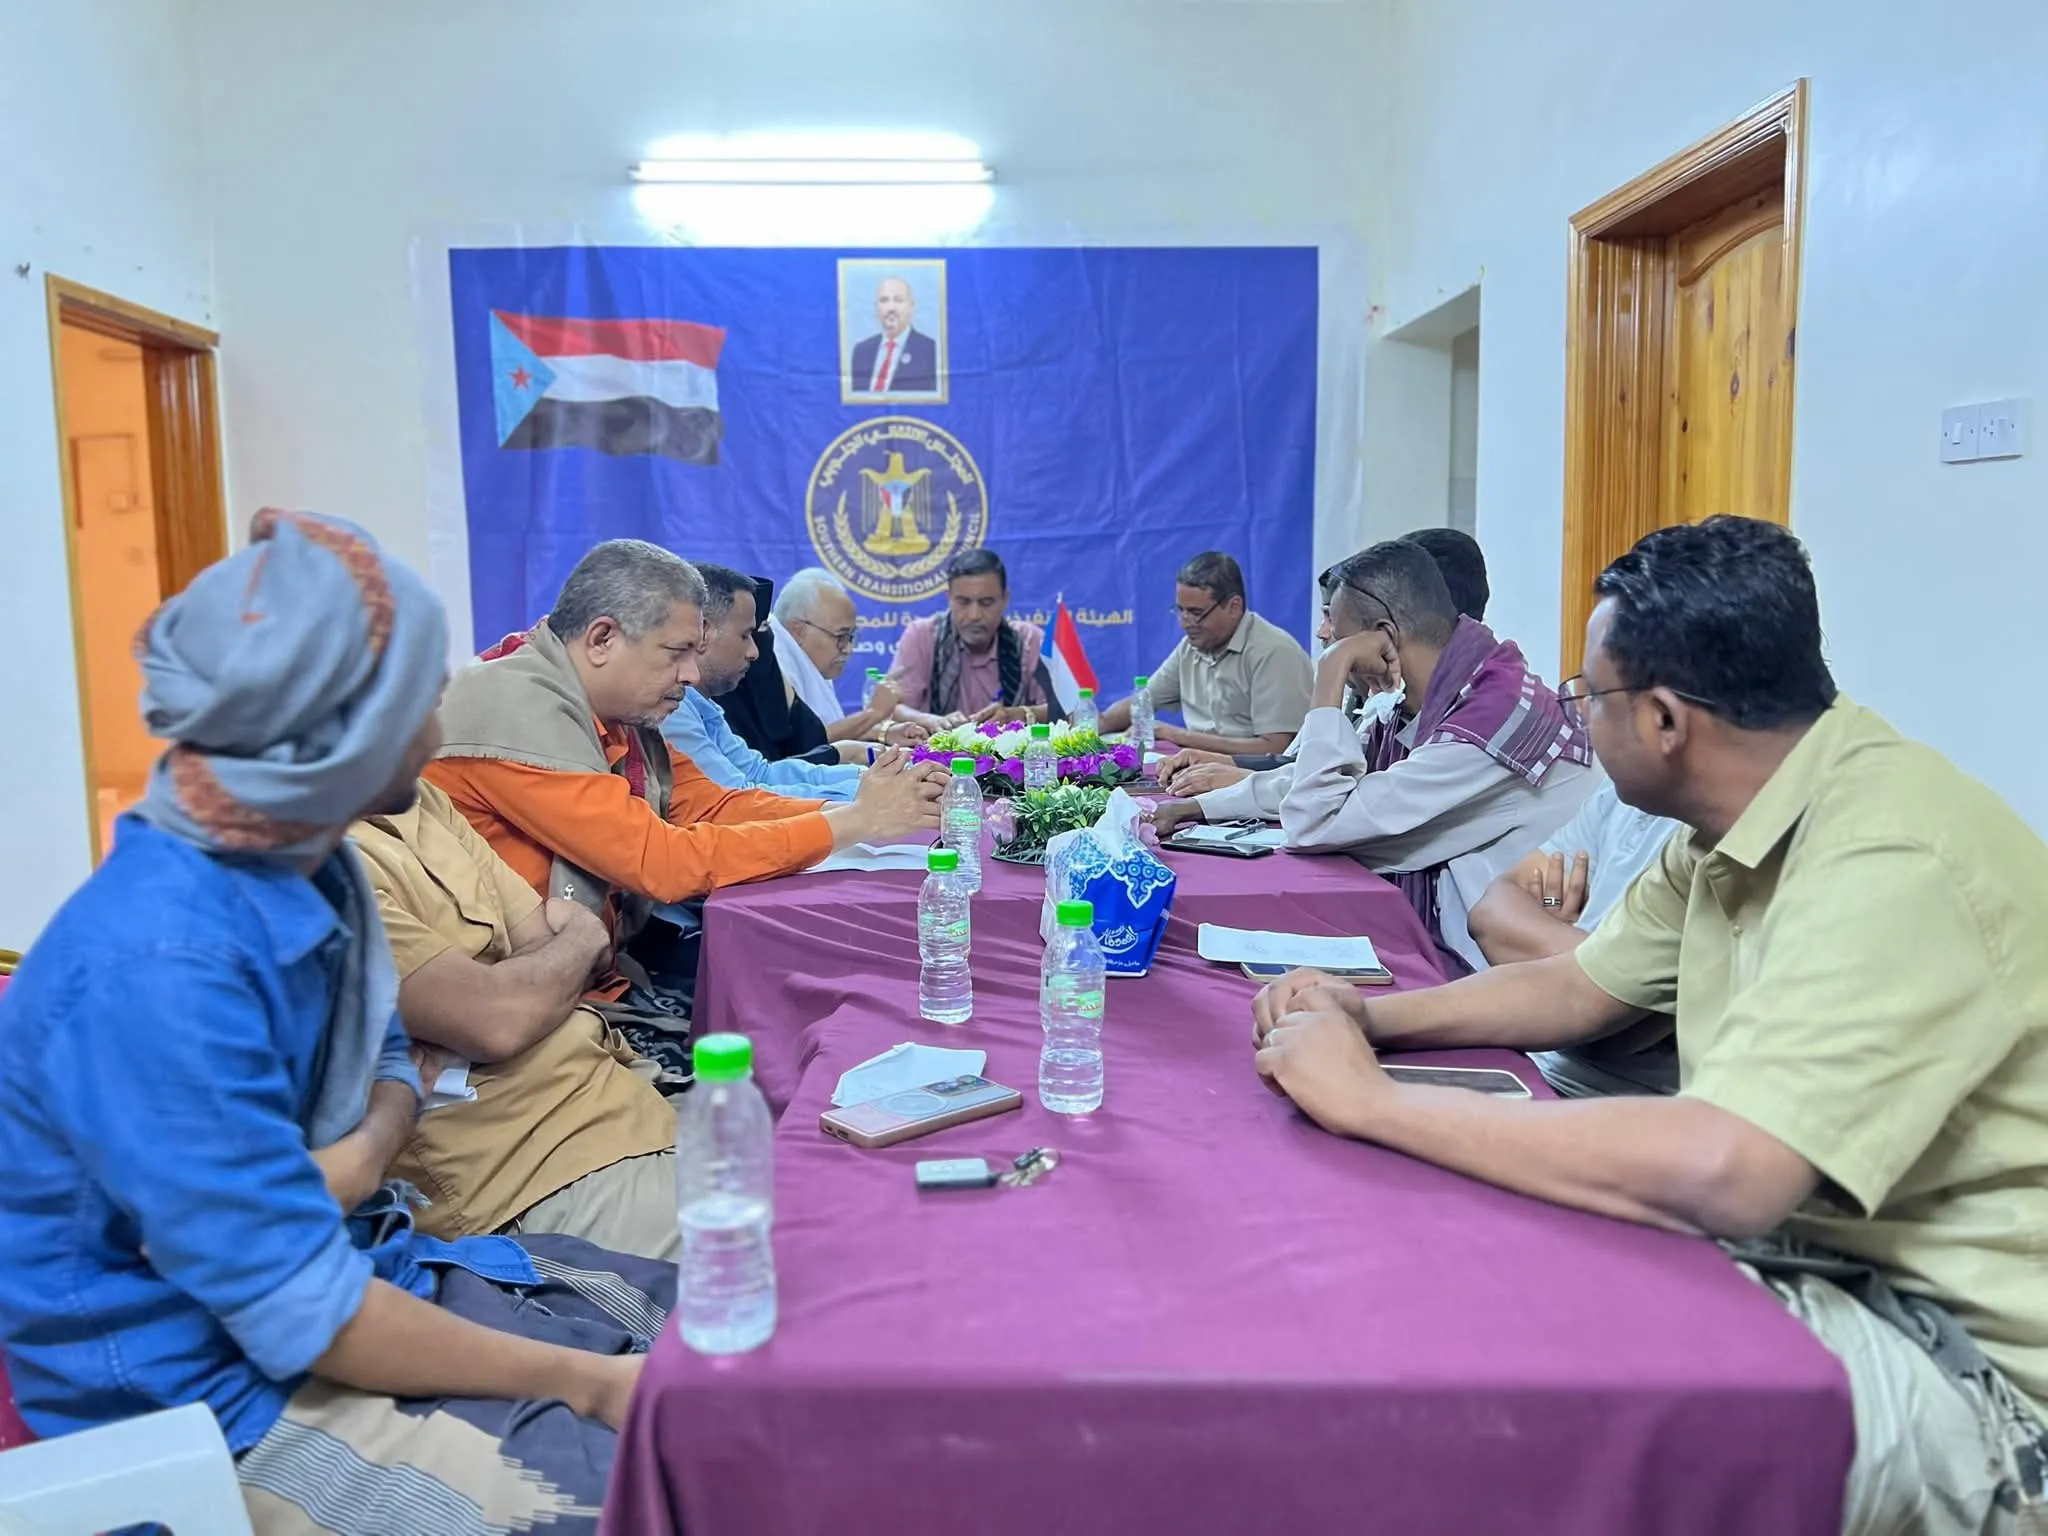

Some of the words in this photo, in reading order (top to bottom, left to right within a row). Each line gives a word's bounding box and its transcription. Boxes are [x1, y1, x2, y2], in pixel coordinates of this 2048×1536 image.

[813, 515, 857, 579] SOUTHERN
[856, 569, 949, 595] TRANSITIONAL
[954, 511, 981, 557] UNCIL
[1076, 607, 1133, 628] الهيئة
